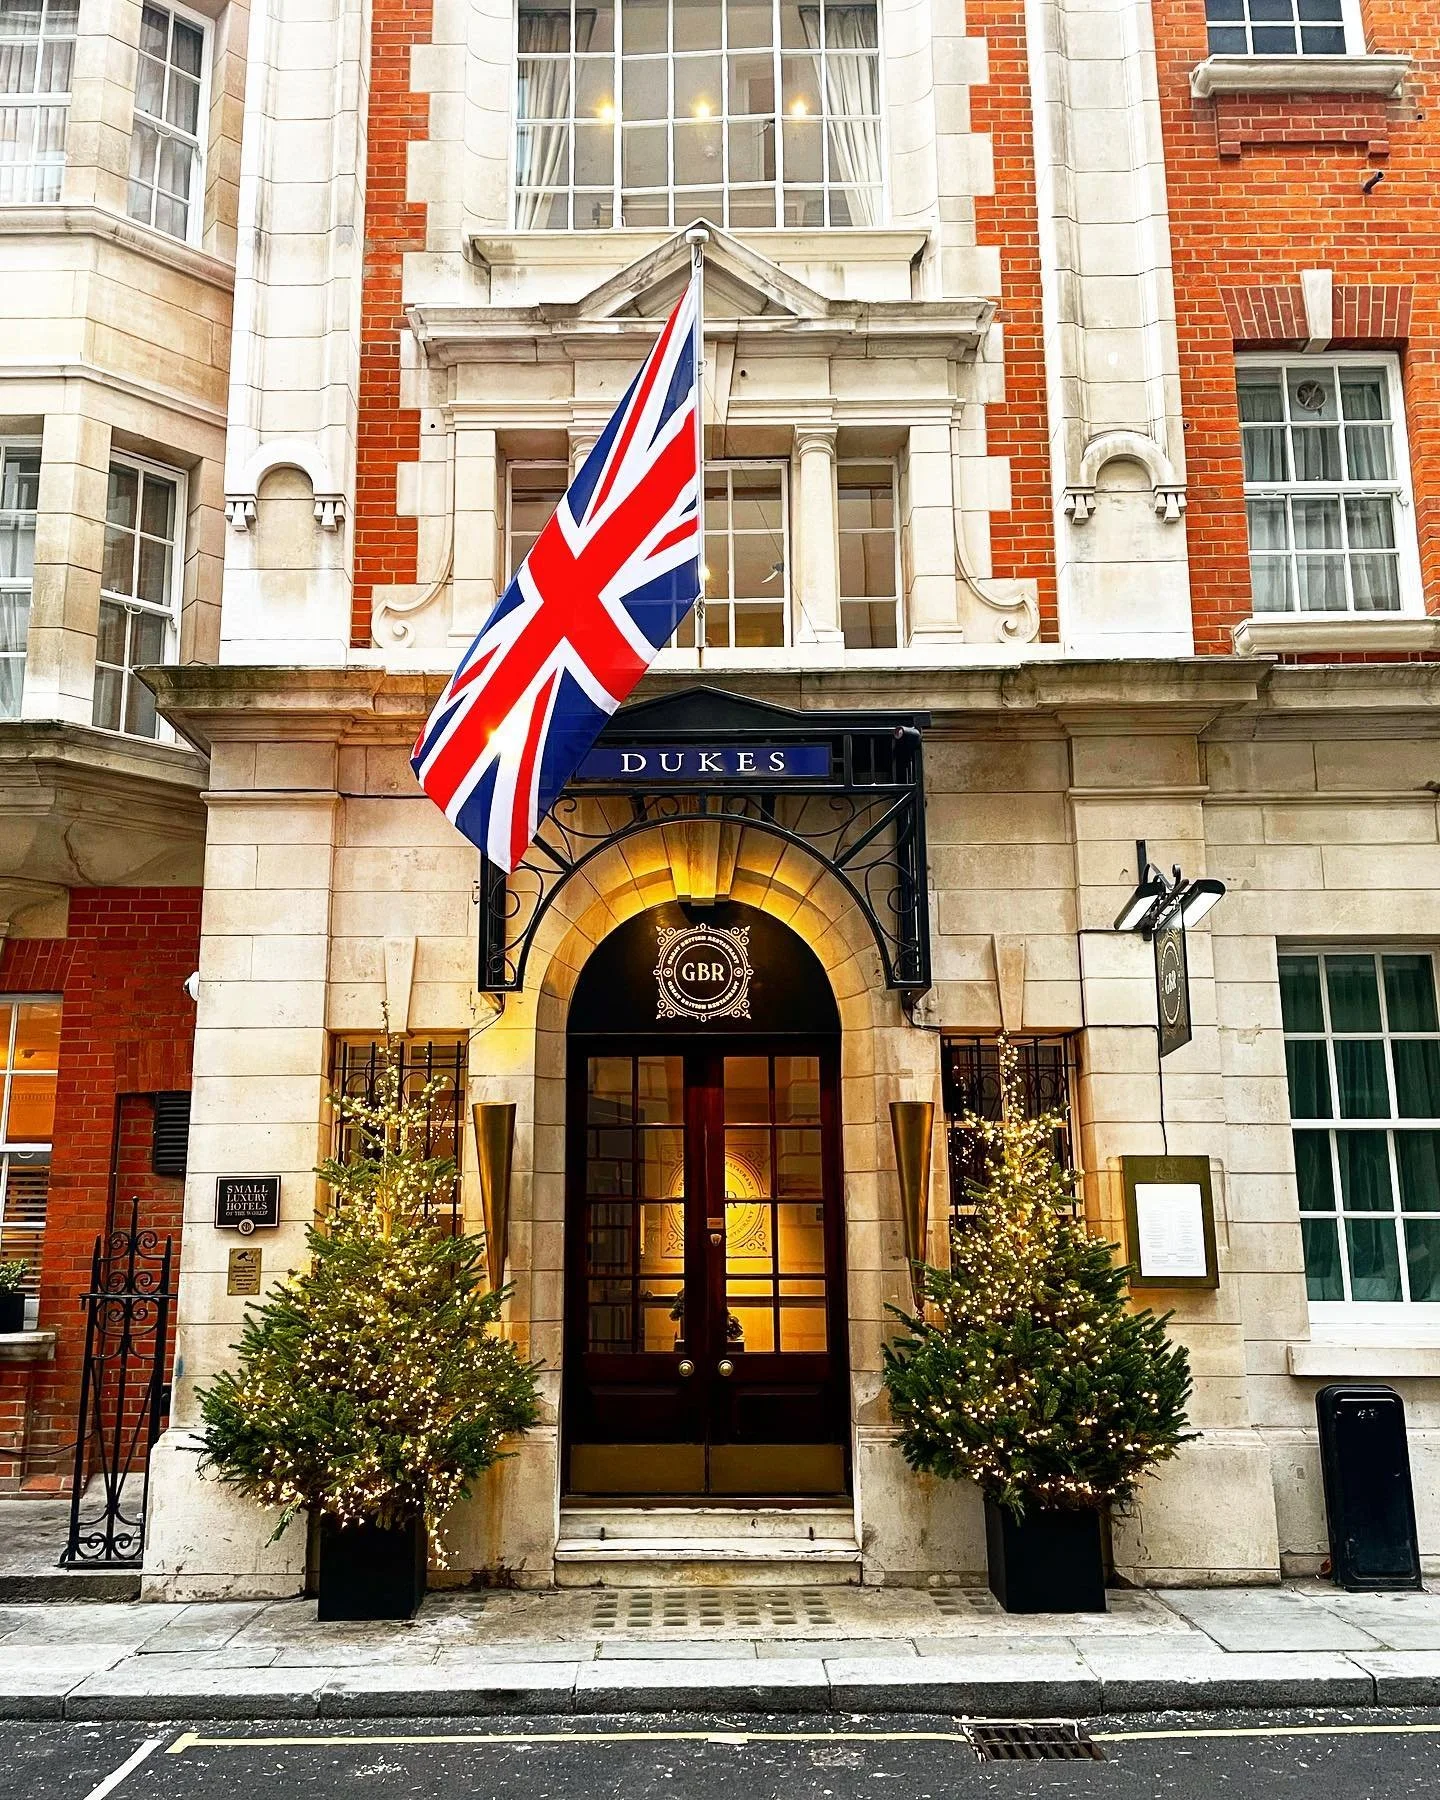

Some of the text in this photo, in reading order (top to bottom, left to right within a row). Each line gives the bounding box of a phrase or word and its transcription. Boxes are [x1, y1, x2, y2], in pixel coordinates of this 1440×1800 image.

[620, 752, 785, 772] DUKES
[682, 962, 725, 981] GBR
[226, 1185, 269, 1194] SMALL
[226, 1193, 267, 1202] LUXURY
[226, 1202, 268, 1211] HOTELS
